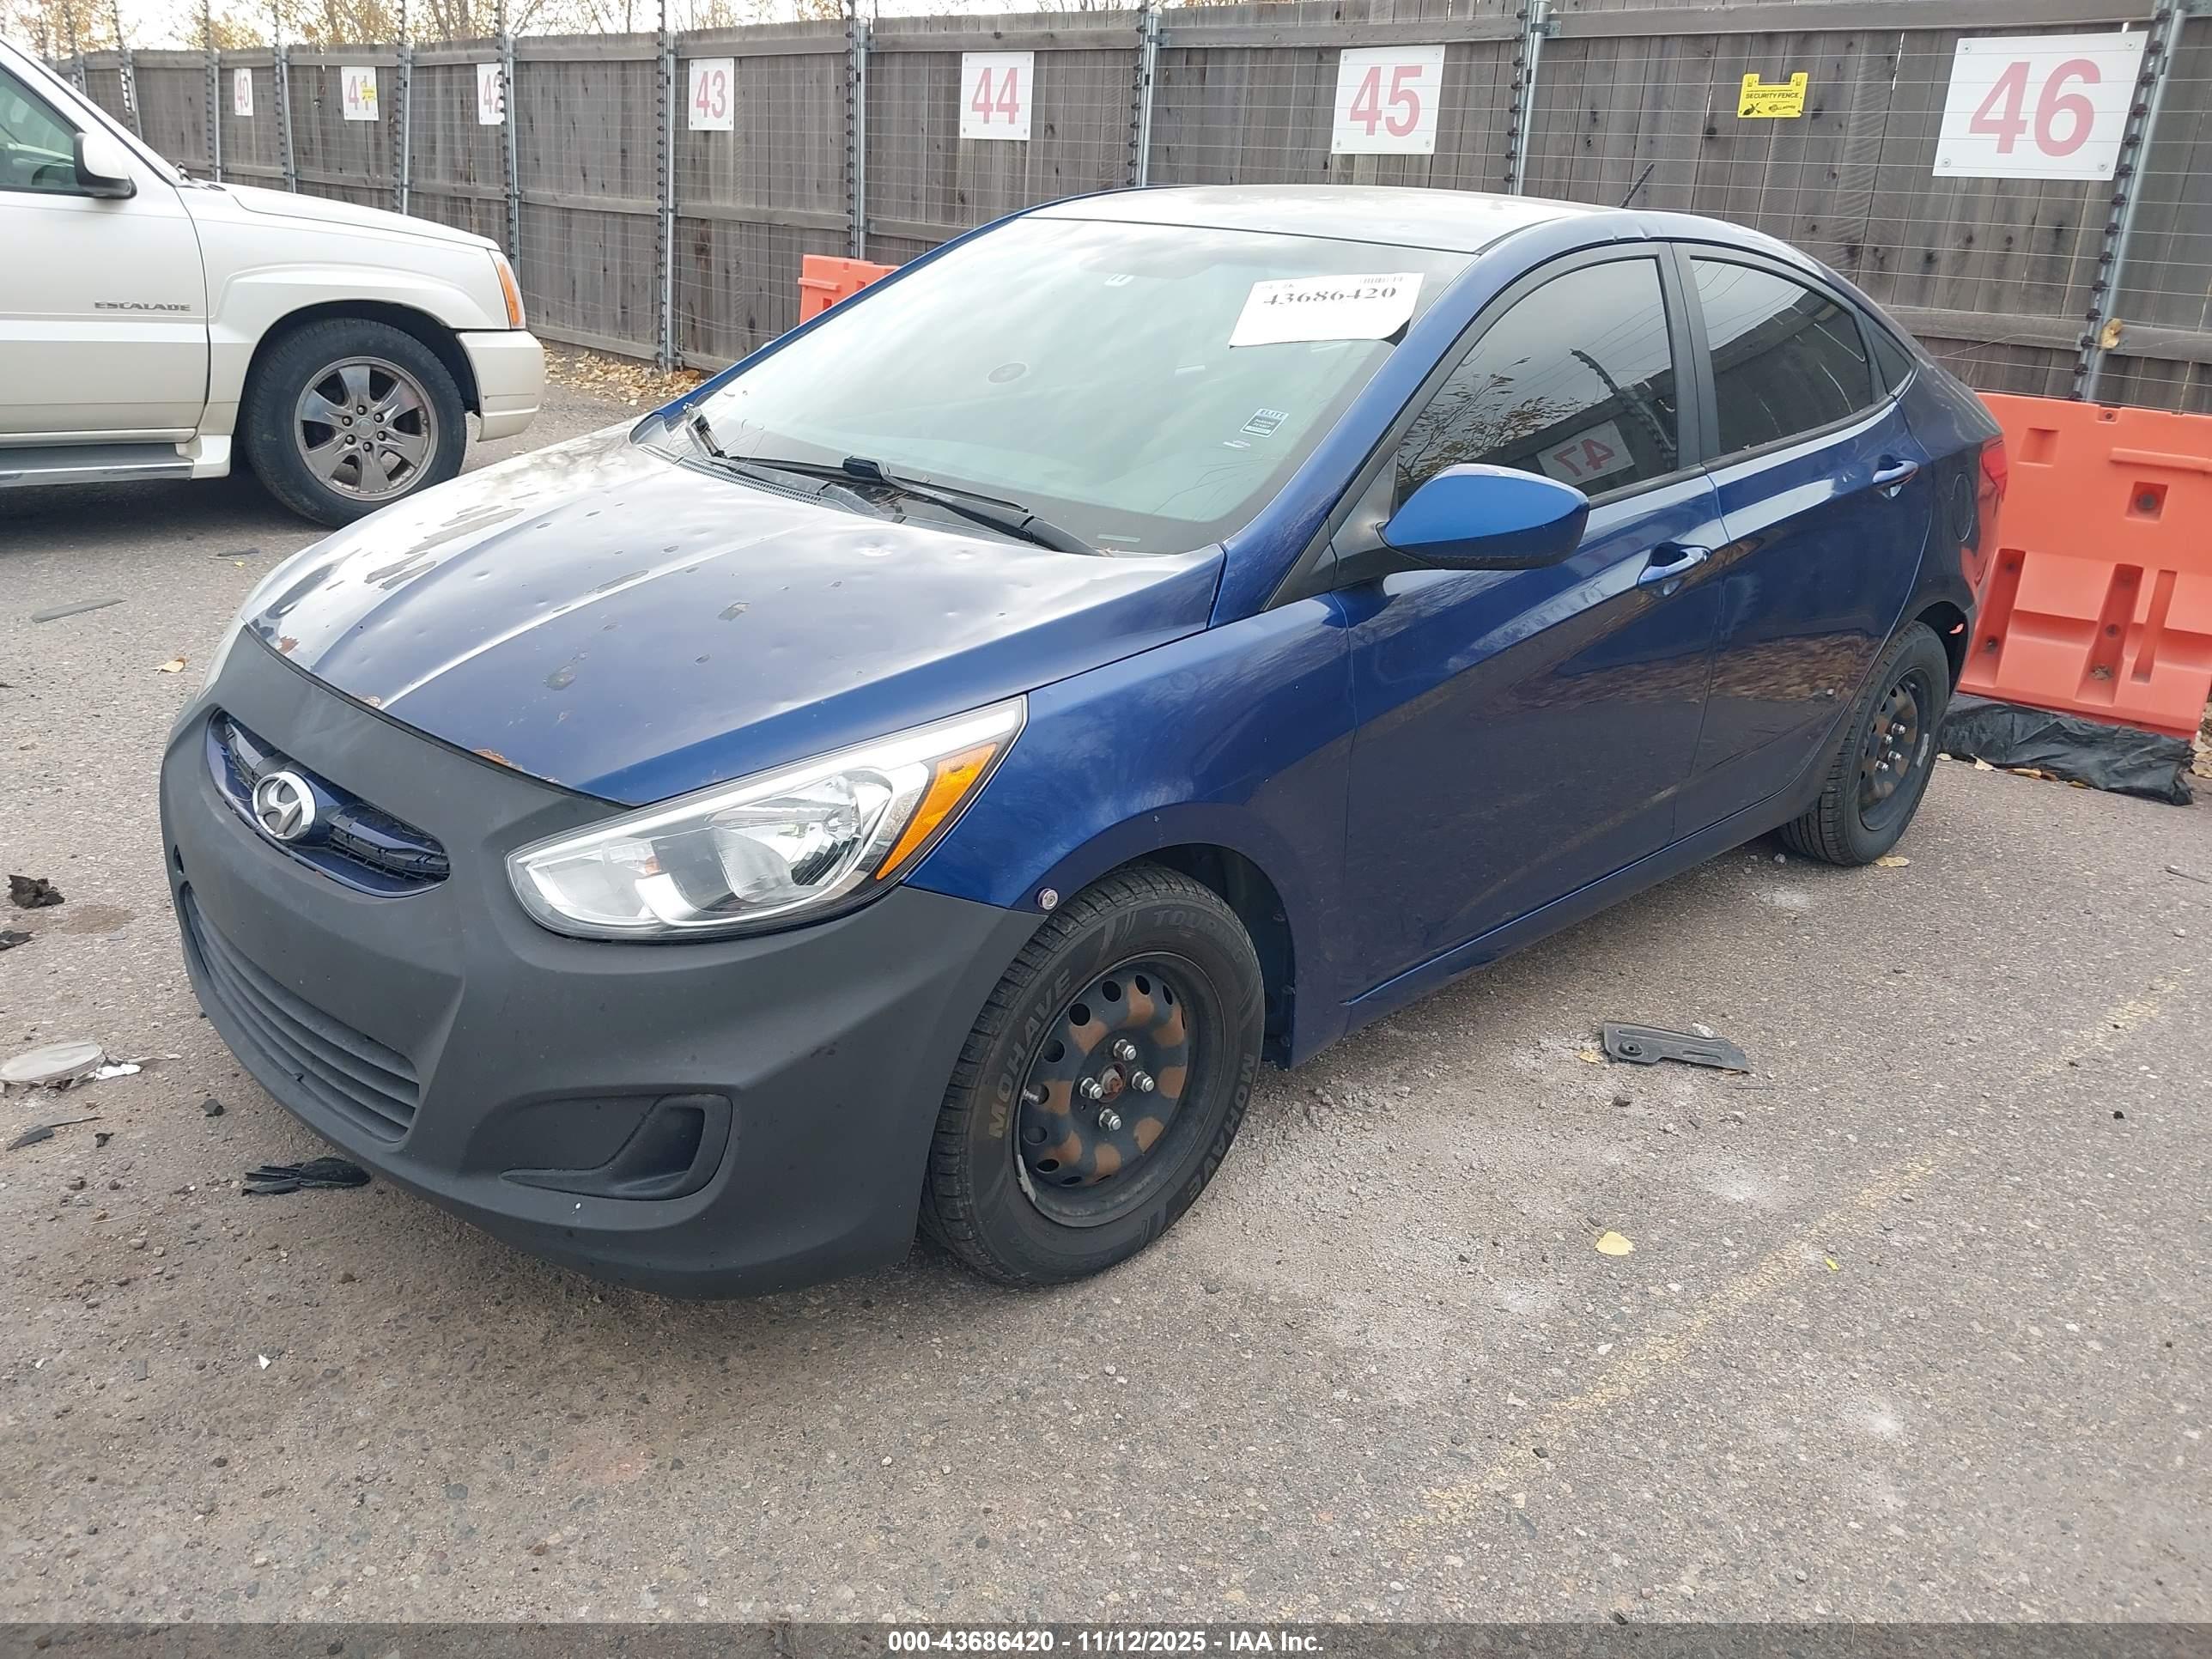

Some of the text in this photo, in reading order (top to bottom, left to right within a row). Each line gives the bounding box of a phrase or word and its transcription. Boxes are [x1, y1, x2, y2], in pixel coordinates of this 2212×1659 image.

[696, 70, 726, 118] 43
[971, 67, 1020, 125] 44
[1350, 64, 1423, 137] 45
[1968, 59, 2101, 157] 46
[94, 301, 192, 312] ESCALADE
[1263, 287, 1397, 306] 43686420
[988, 968, 1072, 1139] MOHAVE
[1188, 1053, 1257, 1202] MOHAVE
